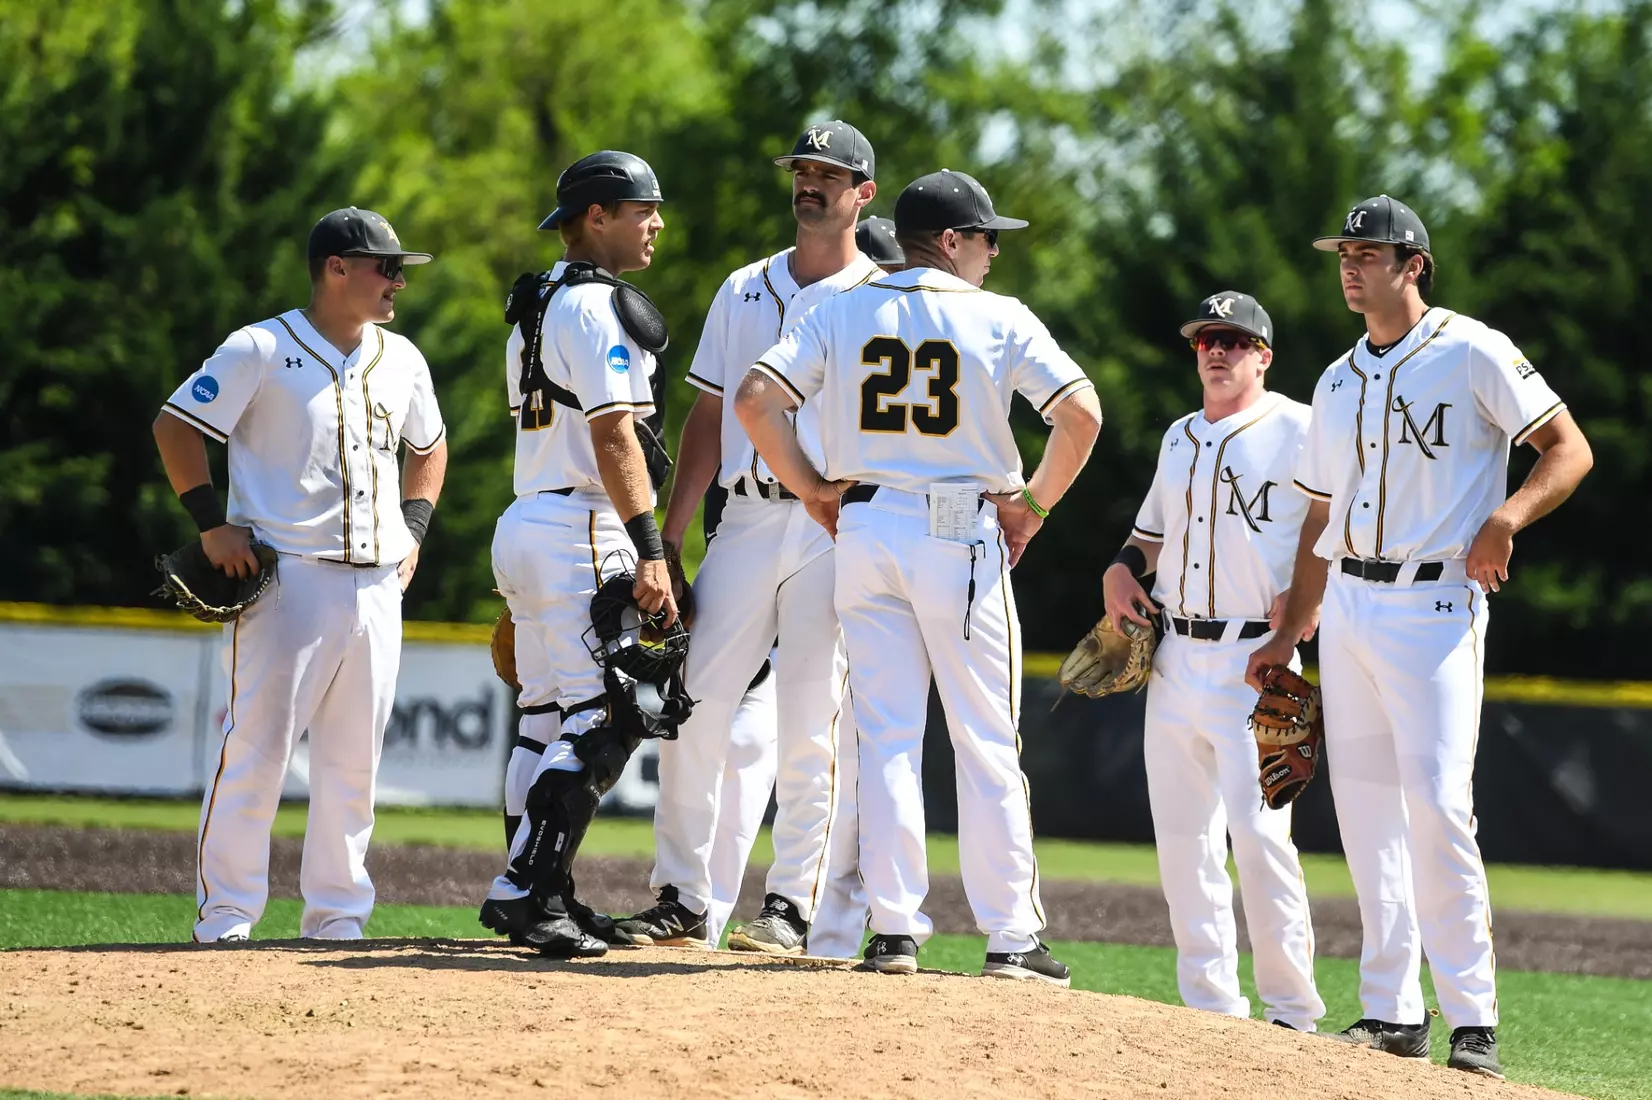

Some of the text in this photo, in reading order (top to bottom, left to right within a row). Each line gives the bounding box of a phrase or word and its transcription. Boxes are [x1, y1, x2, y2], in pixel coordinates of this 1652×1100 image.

[194, 384, 215, 401] NCAA
[859, 334, 961, 438] 23
[1264, 767, 1291, 786] Wilson
[660, 914, 685, 936] N
